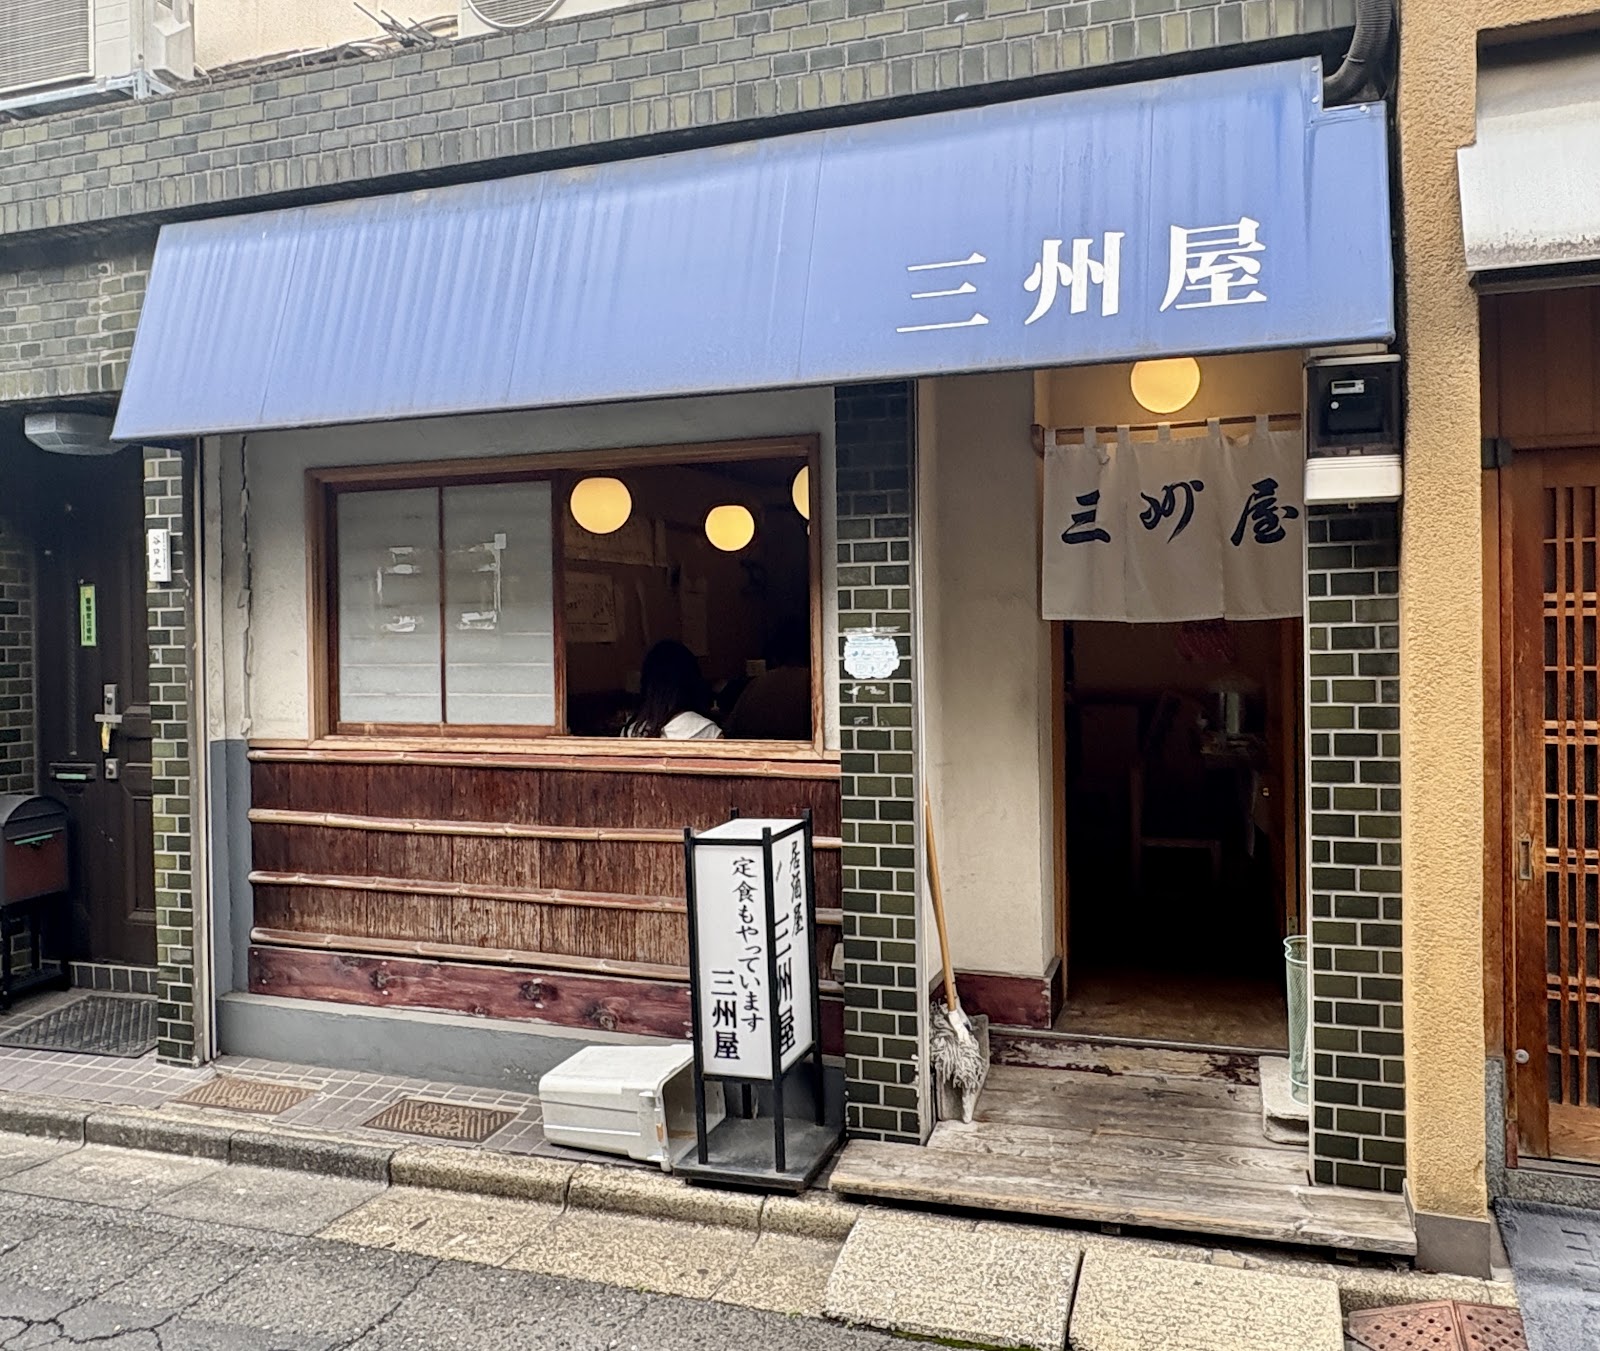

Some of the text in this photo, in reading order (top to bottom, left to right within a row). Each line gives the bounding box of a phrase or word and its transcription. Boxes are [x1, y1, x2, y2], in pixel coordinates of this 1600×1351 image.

[896, 216, 1267, 333] 三州屋
[1061, 477, 1299, 547] 三州屋
[788, 840, 804, 937] 居酒屋
[732, 856, 764, 1033] 定食もやっています
[774, 912, 796, 1056] 三州屋
[711, 969, 741, 1061] 三州屋
